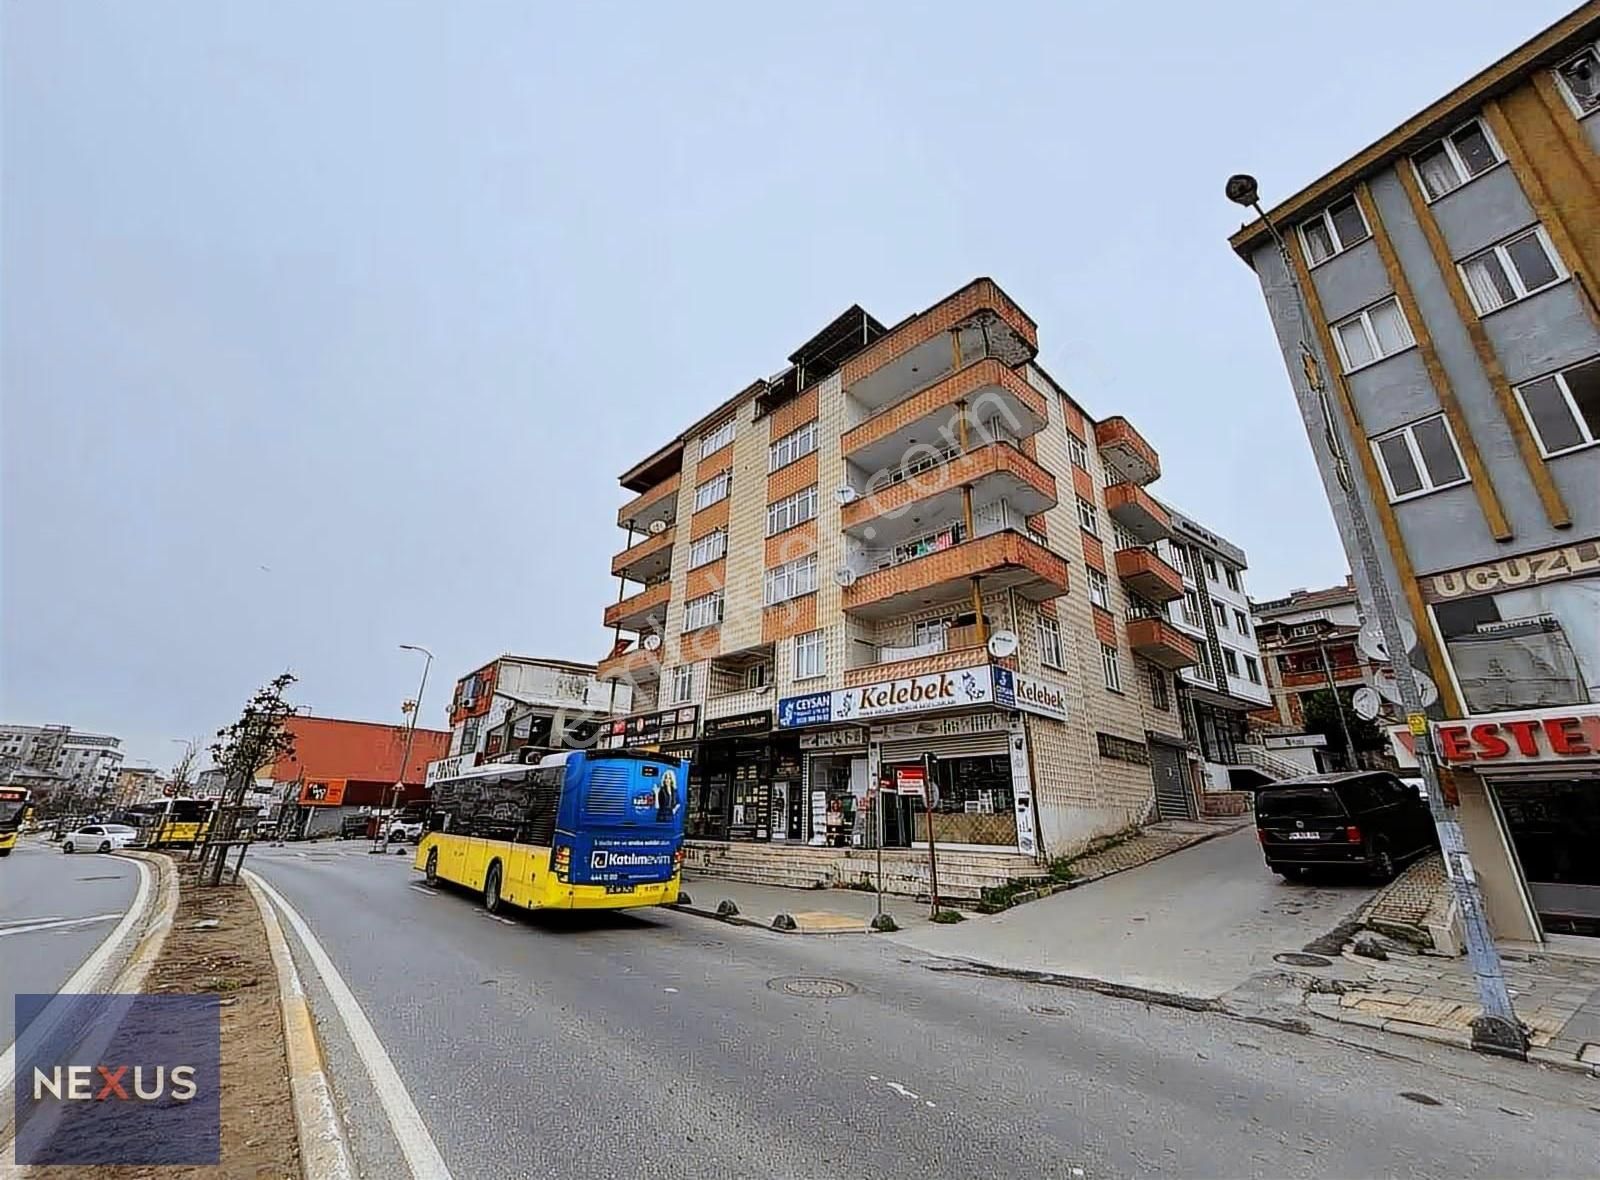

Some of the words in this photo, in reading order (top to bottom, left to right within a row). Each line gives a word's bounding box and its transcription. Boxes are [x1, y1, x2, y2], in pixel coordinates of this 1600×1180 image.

[1433, 541, 1600, 597] UCUZL
[858, 674, 955, 710] Kelebek
[1016, 679, 1065, 710] Kelebek
